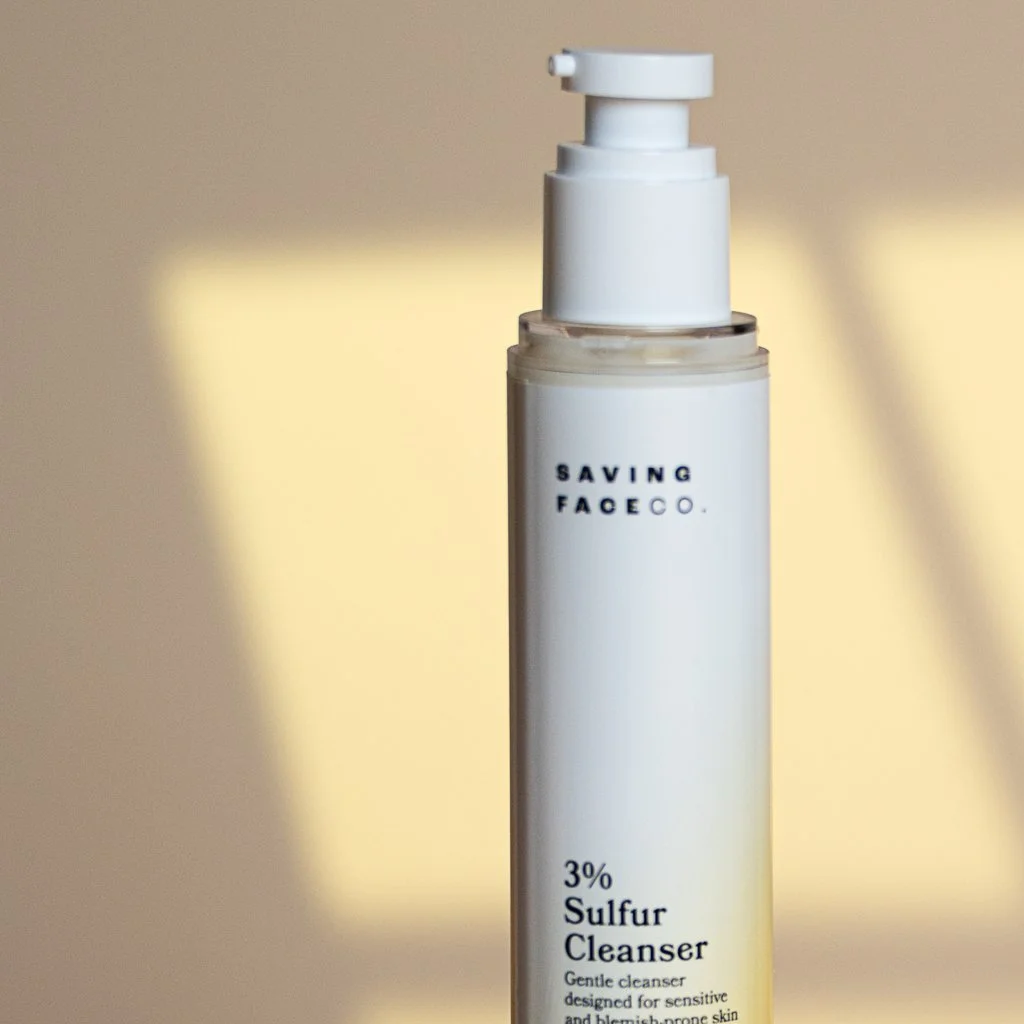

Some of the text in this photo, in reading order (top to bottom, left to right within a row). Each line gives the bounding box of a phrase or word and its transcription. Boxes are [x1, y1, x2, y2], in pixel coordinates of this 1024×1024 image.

[556, 464, 691, 484] SAVING
[564, 860, 613, 891] 3%
[564, 896, 668, 927] Sulfur
[564, 933, 709, 963] Cleanser
[564, 971, 687, 989] Gentle cleanser
[564, 991, 728, 1012] designed for sensitive
[712, 1009, 739, 1024] skin
